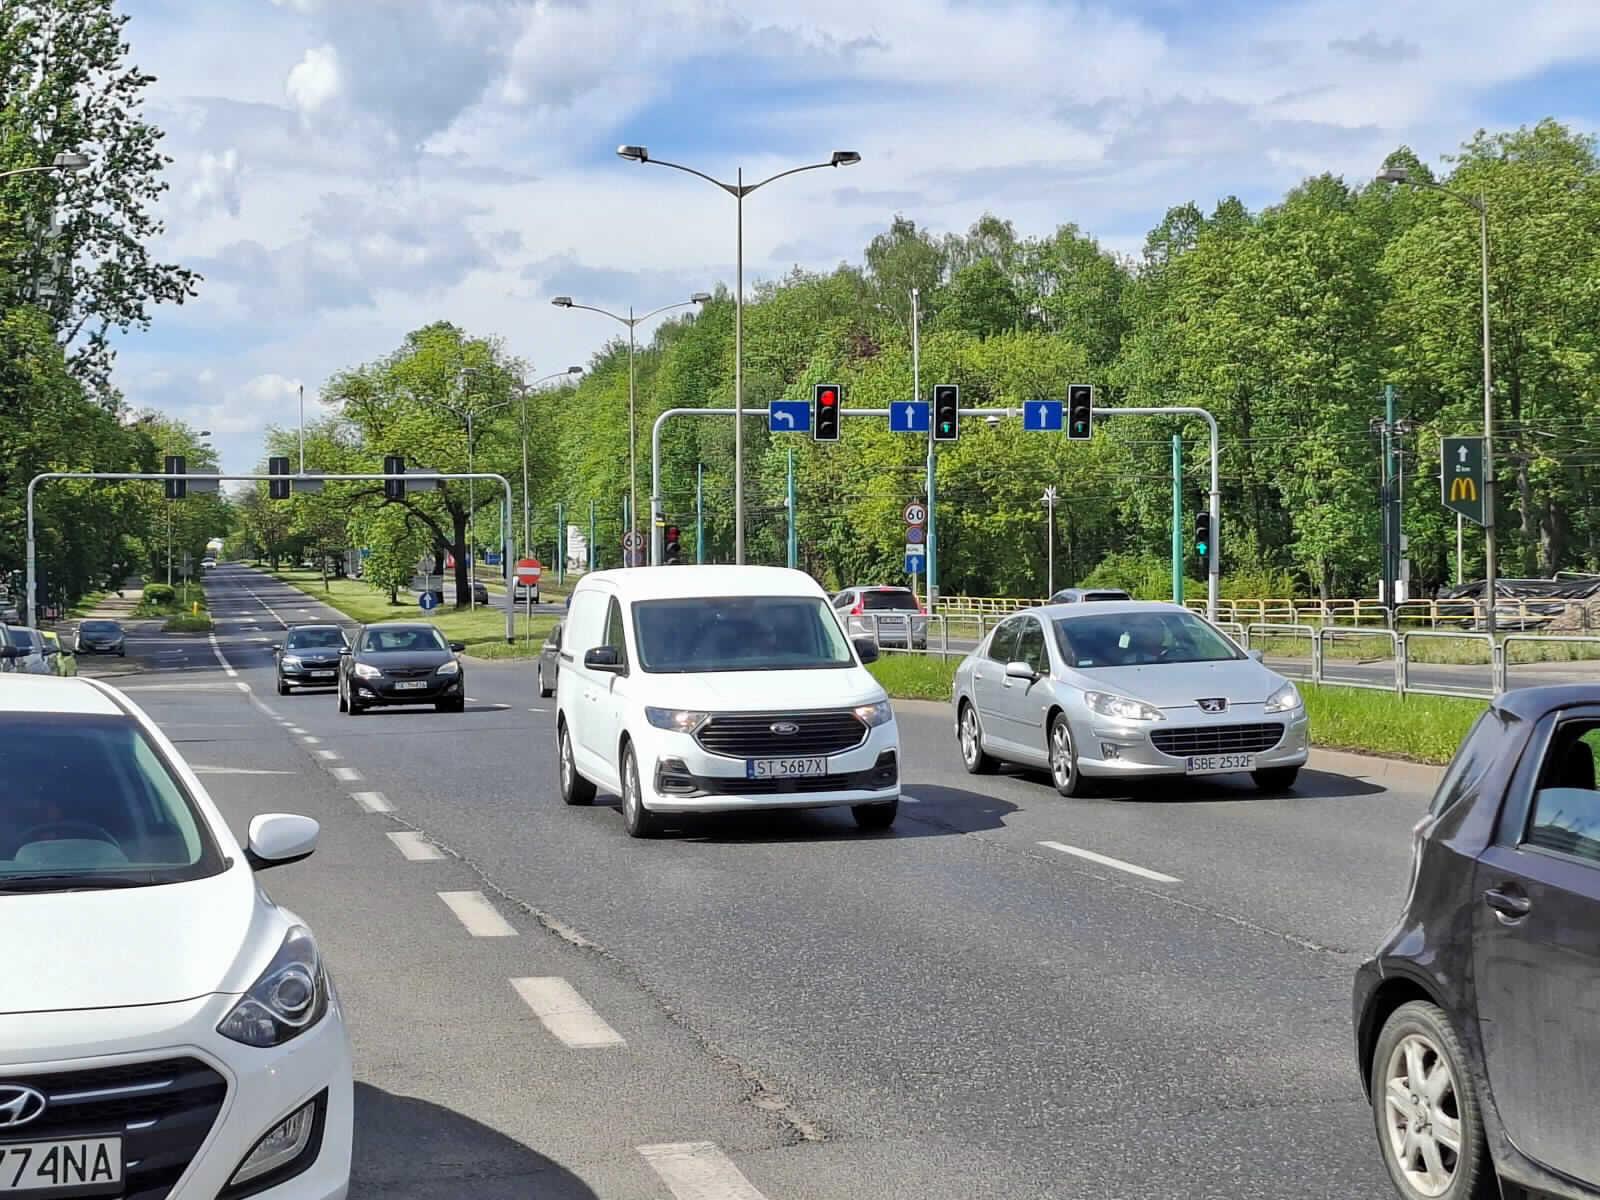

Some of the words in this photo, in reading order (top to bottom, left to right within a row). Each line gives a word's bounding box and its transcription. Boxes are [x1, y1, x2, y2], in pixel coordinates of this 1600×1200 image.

[908, 508, 924, 521] 60
[625, 535, 642, 548] 60
[757, 760, 774, 775] ST
[780, 759, 823, 774] 5687X
[1195, 757, 1216, 770] SBE
[1219, 754, 1254, 769] 2532F
[0, 1143, 113, 1187] 74NA
